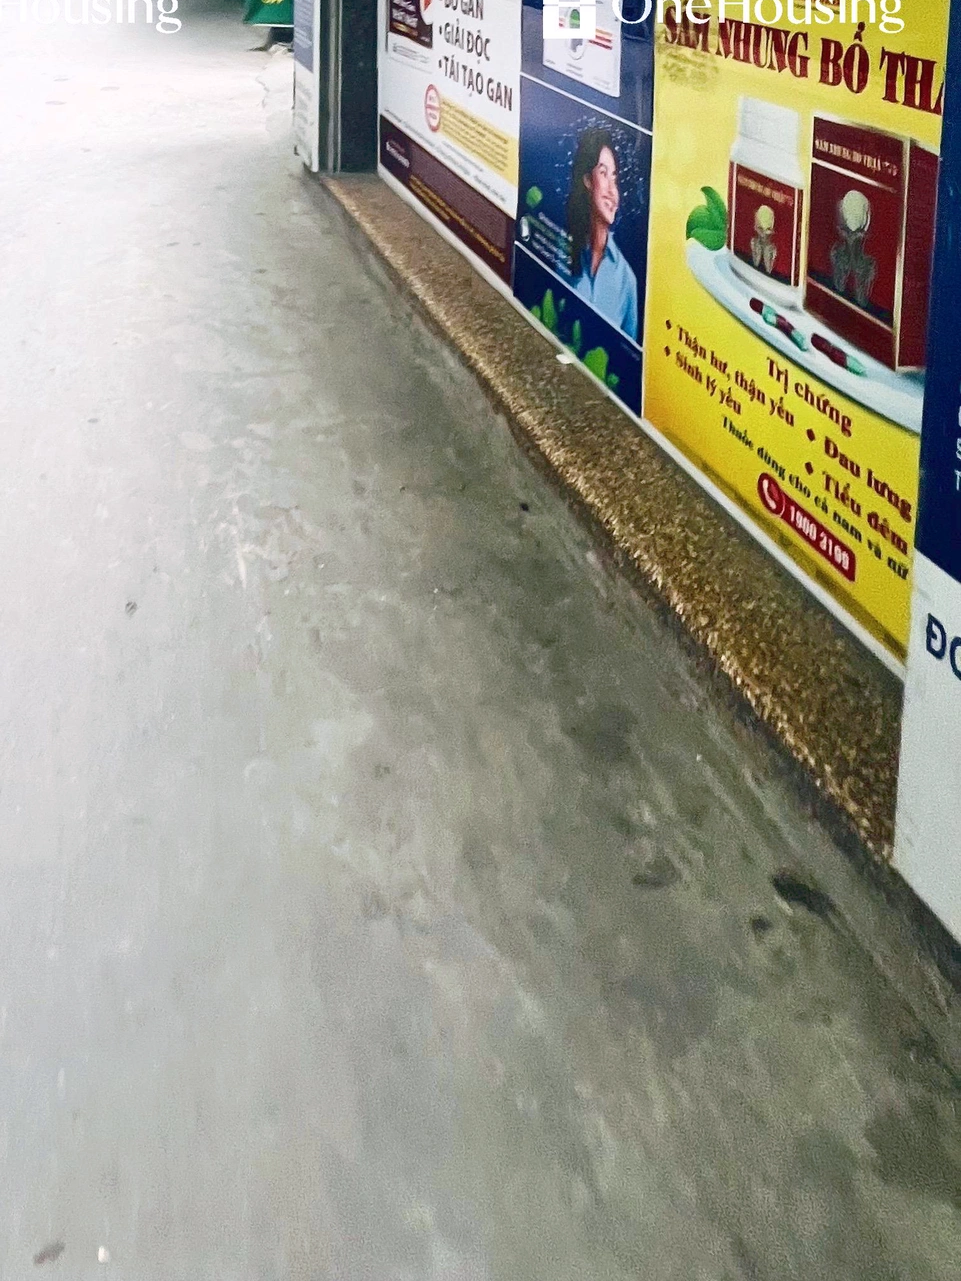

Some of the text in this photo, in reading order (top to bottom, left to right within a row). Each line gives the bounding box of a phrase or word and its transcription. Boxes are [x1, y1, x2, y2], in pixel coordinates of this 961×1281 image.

[444, 18, 465, 51] GIẢI
[466, 29, 491, 64] ĐỘC
[715, 15, 811, 79] NHUNG
[818, 21, 870, 95] BỔ
[443, 54, 460, 83] TÁI
[461, 64, 484, 98] TẠO
[486, 77, 513, 112] GAN
[675, 351, 742, 416] Sinh lý yếu
[676, 324, 707, 361] Thận
[734, 370, 766, 406] thận
[768, 396, 795, 428] yếu
[766, 356, 853, 438] Trị chứng
[788, 473, 812, 499] cho
[832, 509, 862, 543] nam
[822, 471, 908, 556] Tiểu đêm
[824, 436, 912, 524] Đau lưng
[789, 504, 818, 541] 1900
